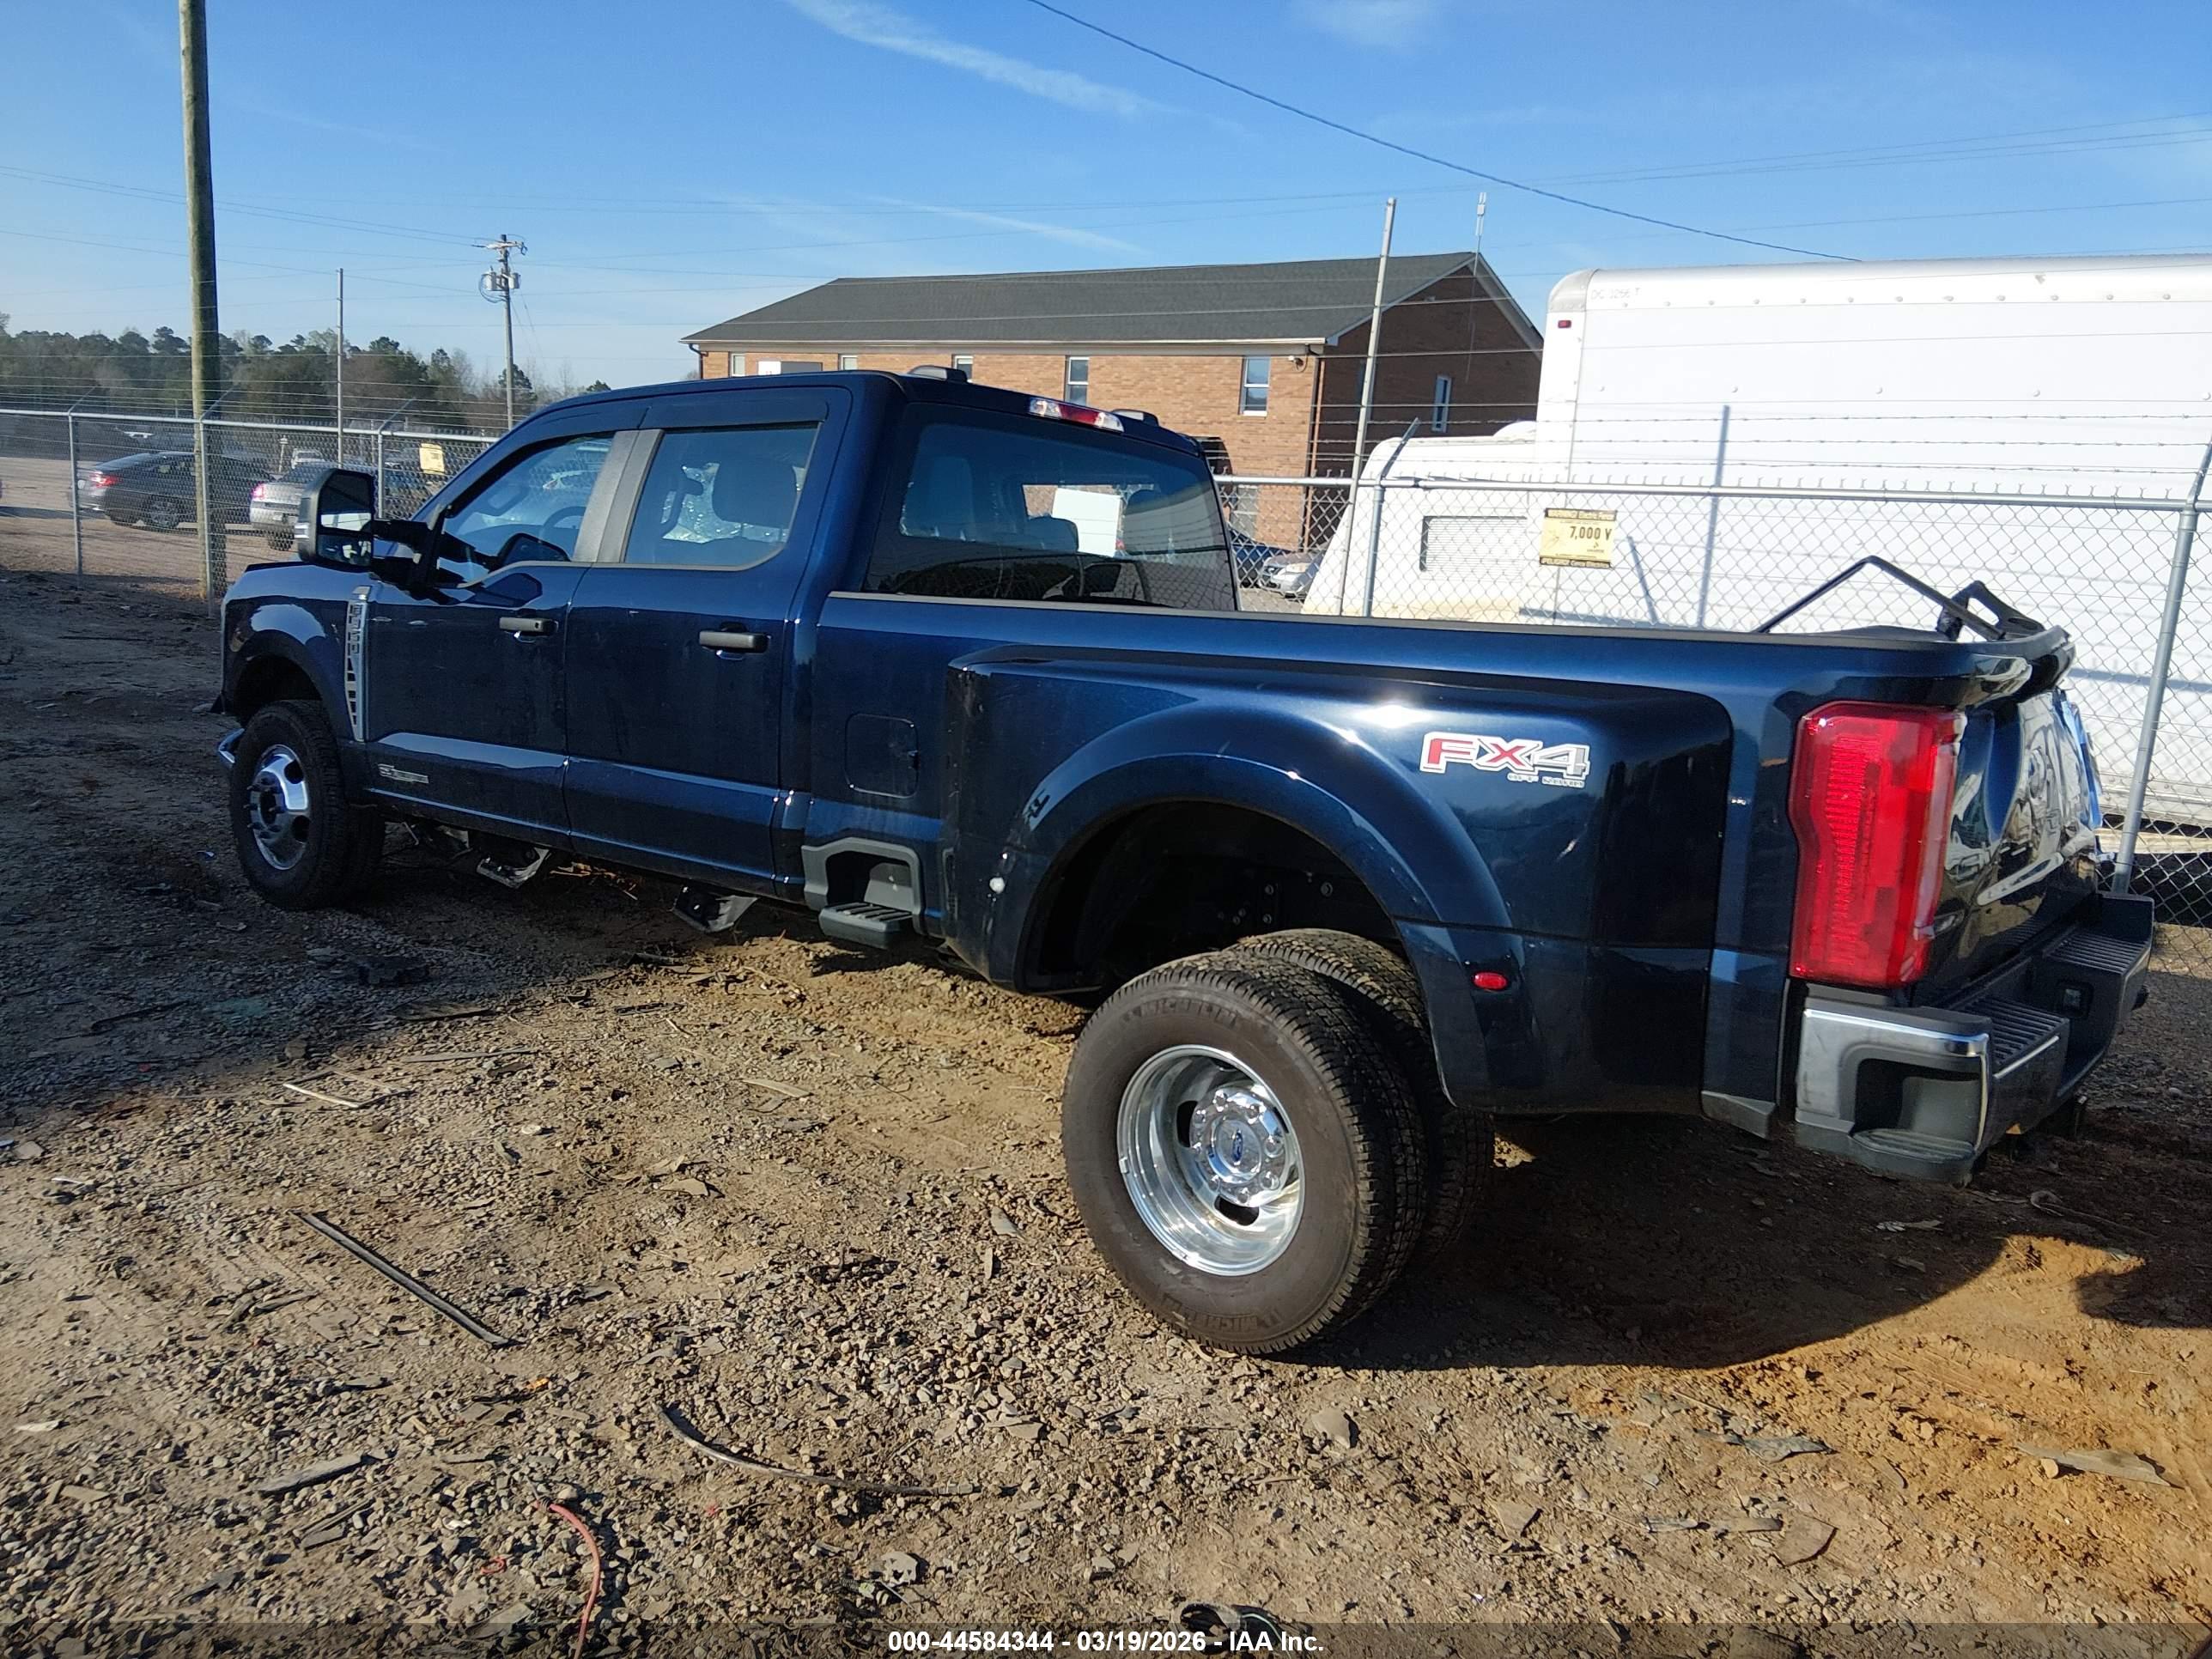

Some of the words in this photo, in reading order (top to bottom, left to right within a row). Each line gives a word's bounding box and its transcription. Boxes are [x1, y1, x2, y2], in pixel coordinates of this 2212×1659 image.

[1570, 526, 1601, 540] 7,000
[1605, 528, 1613, 541] V
[1420, 732, 1589, 780] FX4
